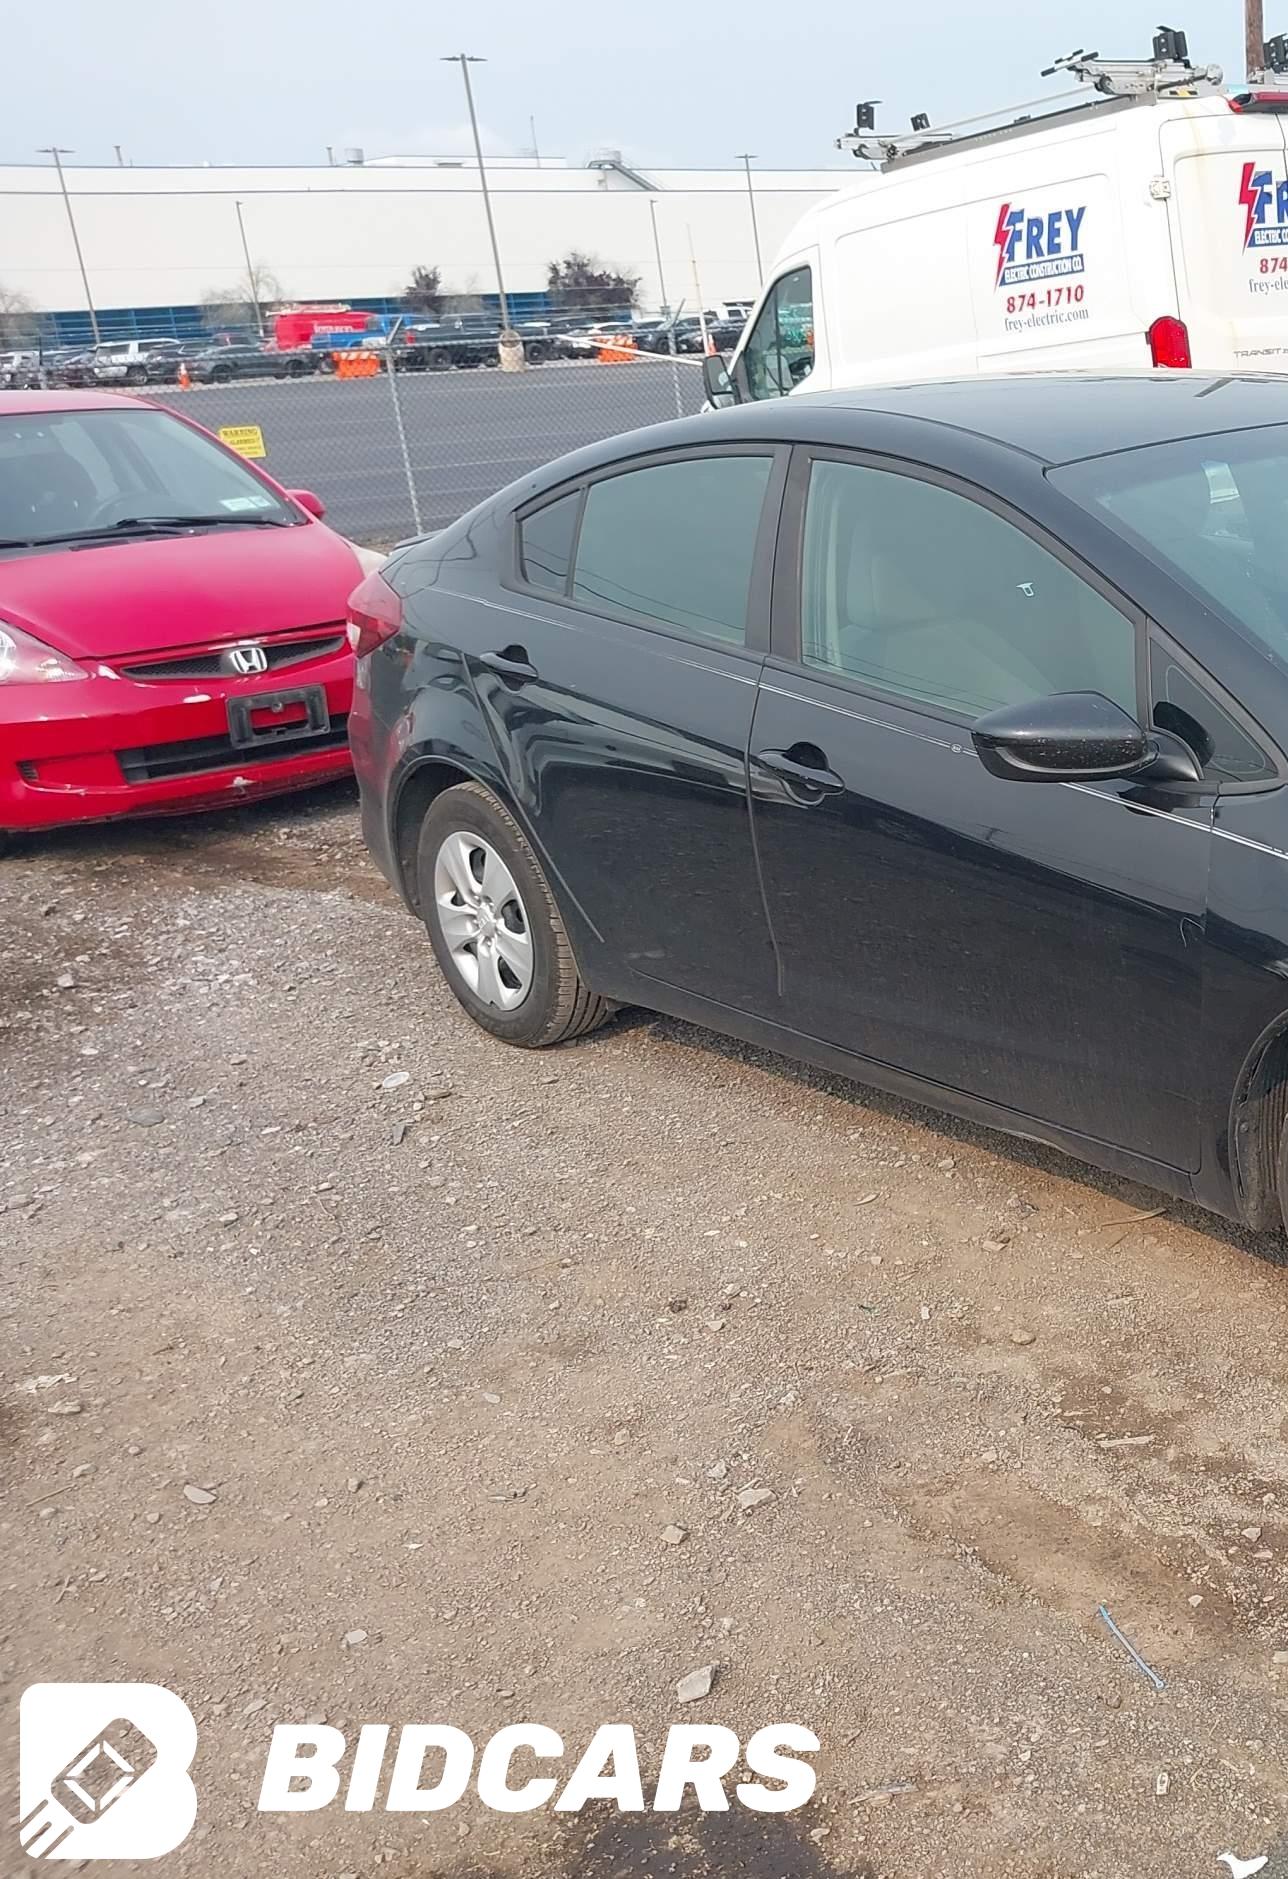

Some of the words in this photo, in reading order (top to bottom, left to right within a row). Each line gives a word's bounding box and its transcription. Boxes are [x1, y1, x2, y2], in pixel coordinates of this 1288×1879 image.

[1005, 206, 1087, 263] FREY
[1254, 228, 1281, 245] ELECTRIC
[1029, 257, 1073, 279] CONSTRUCTION
[1006, 284, 1085, 314] 874-1710
[1004, 308, 1090, 332] frey-electric.com
[1233, 346, 1282, 358] TRANSIT
[222, 429, 257, 437] WARNING
